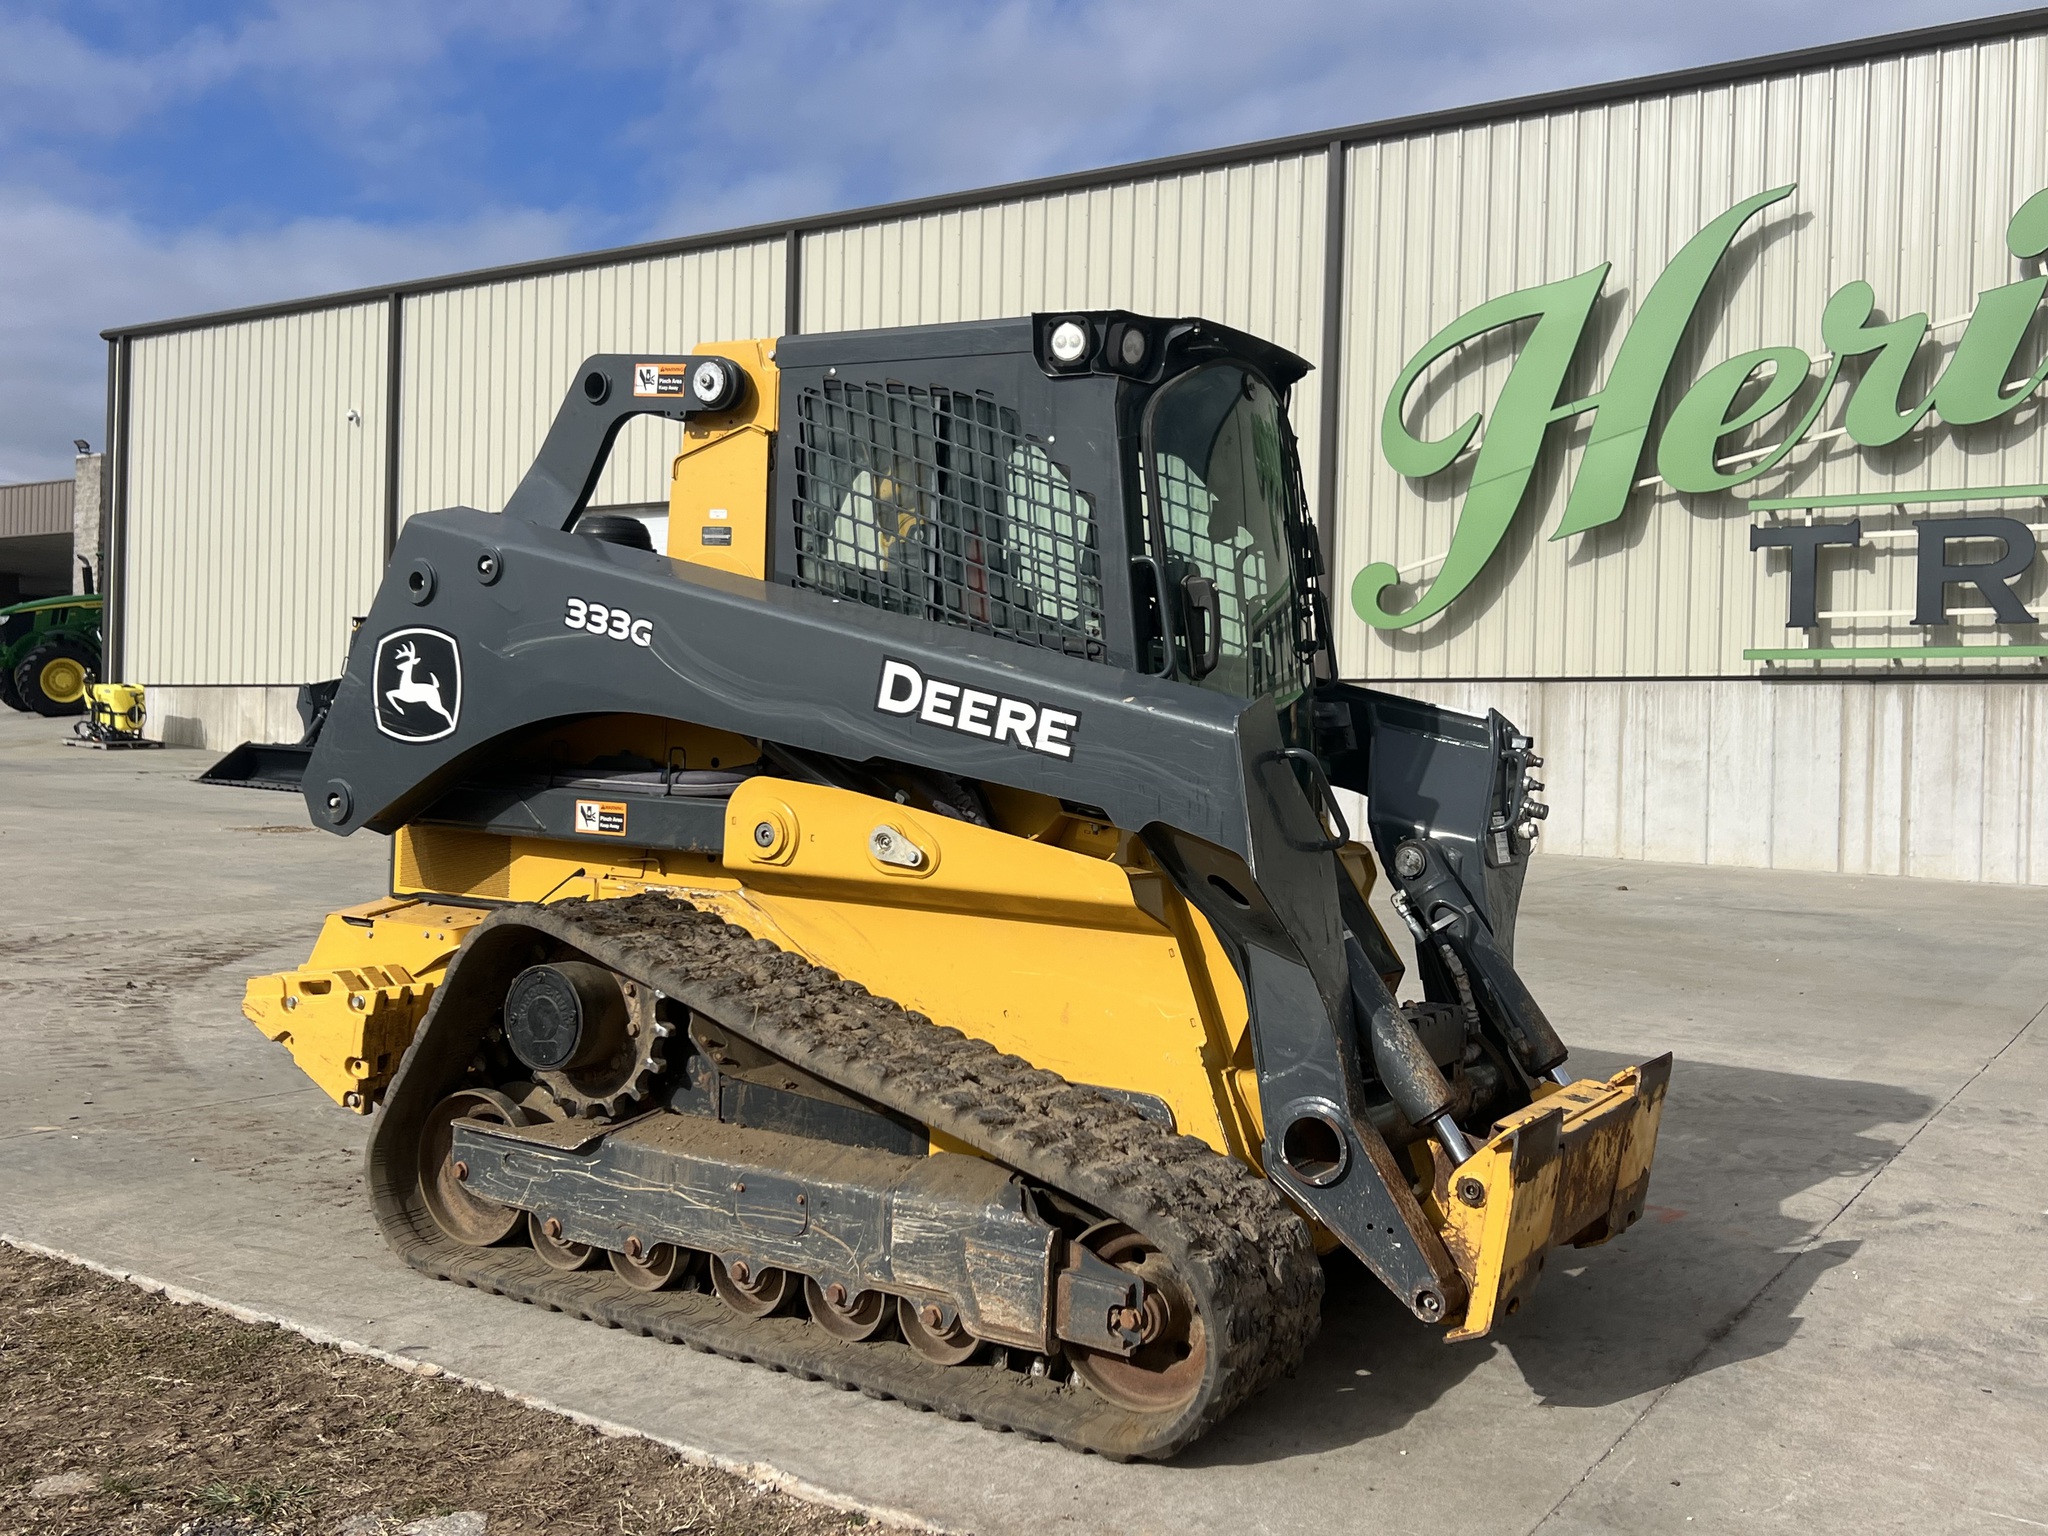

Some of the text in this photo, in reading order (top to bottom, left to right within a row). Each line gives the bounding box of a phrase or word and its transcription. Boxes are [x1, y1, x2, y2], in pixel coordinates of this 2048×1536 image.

[1750, 517, 2039, 628] TR
[565, 597, 653, 647] 333G
[877, 660, 1078, 758] DEERE
